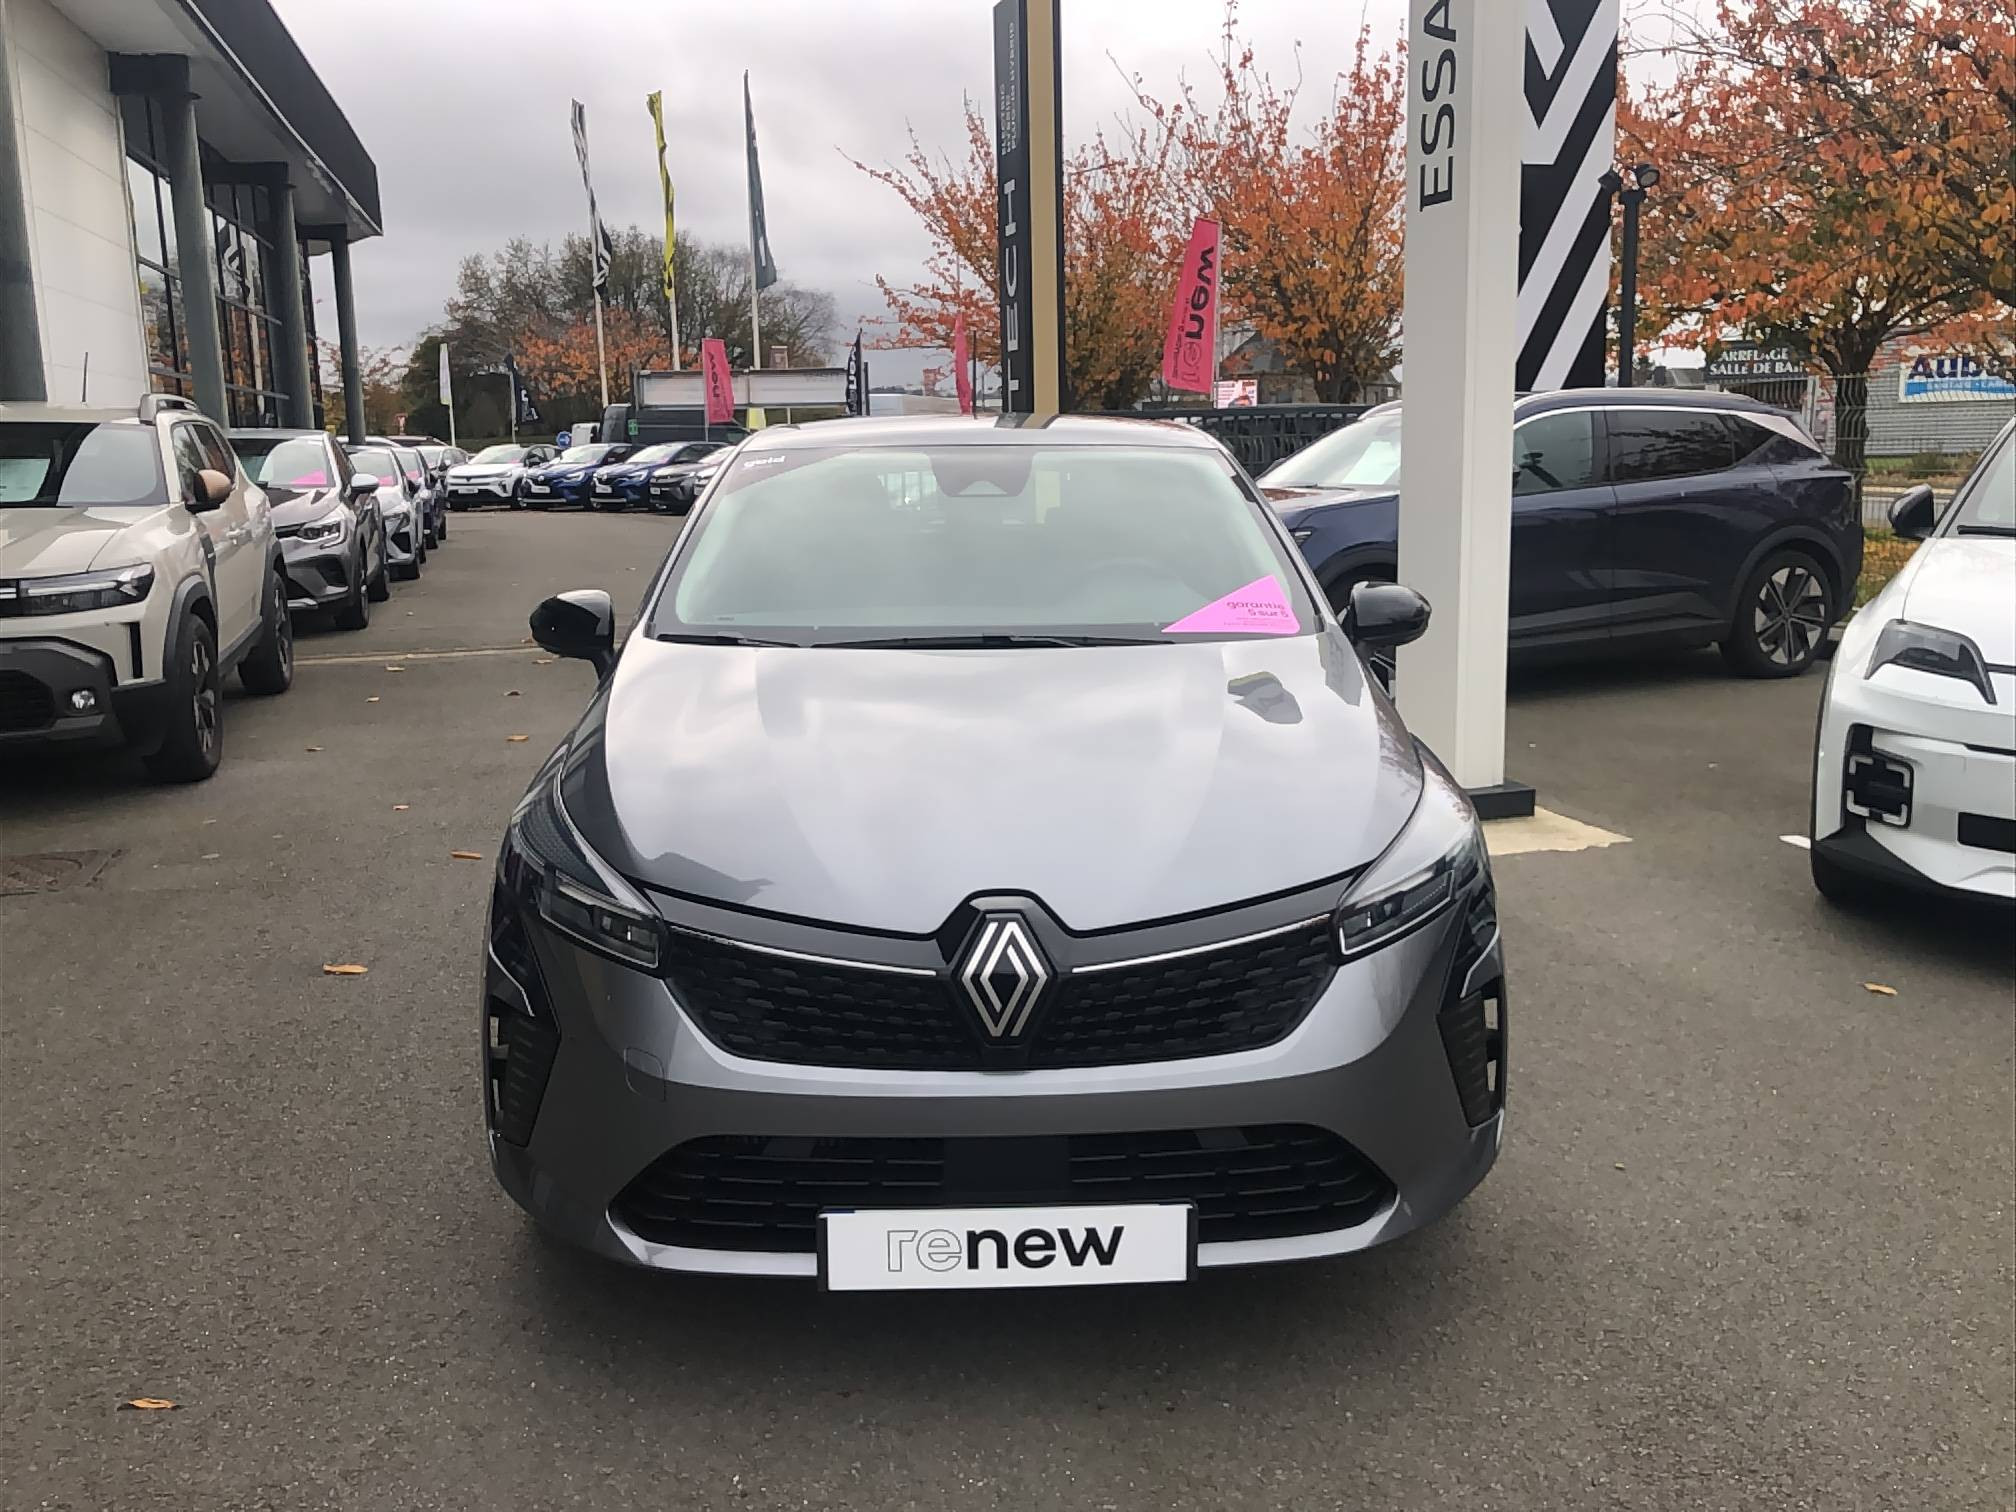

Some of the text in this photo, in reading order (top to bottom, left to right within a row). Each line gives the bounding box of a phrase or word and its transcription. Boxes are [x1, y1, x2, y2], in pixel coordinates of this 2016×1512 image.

[1420, 0, 1456, 212] ESSA
[1003, 178, 1020, 413] TECH
[1710, 362, 1749, 376] SALLE
[1752, 361, 1773, 374] DE
[886, 1225, 1125, 1273] renew
